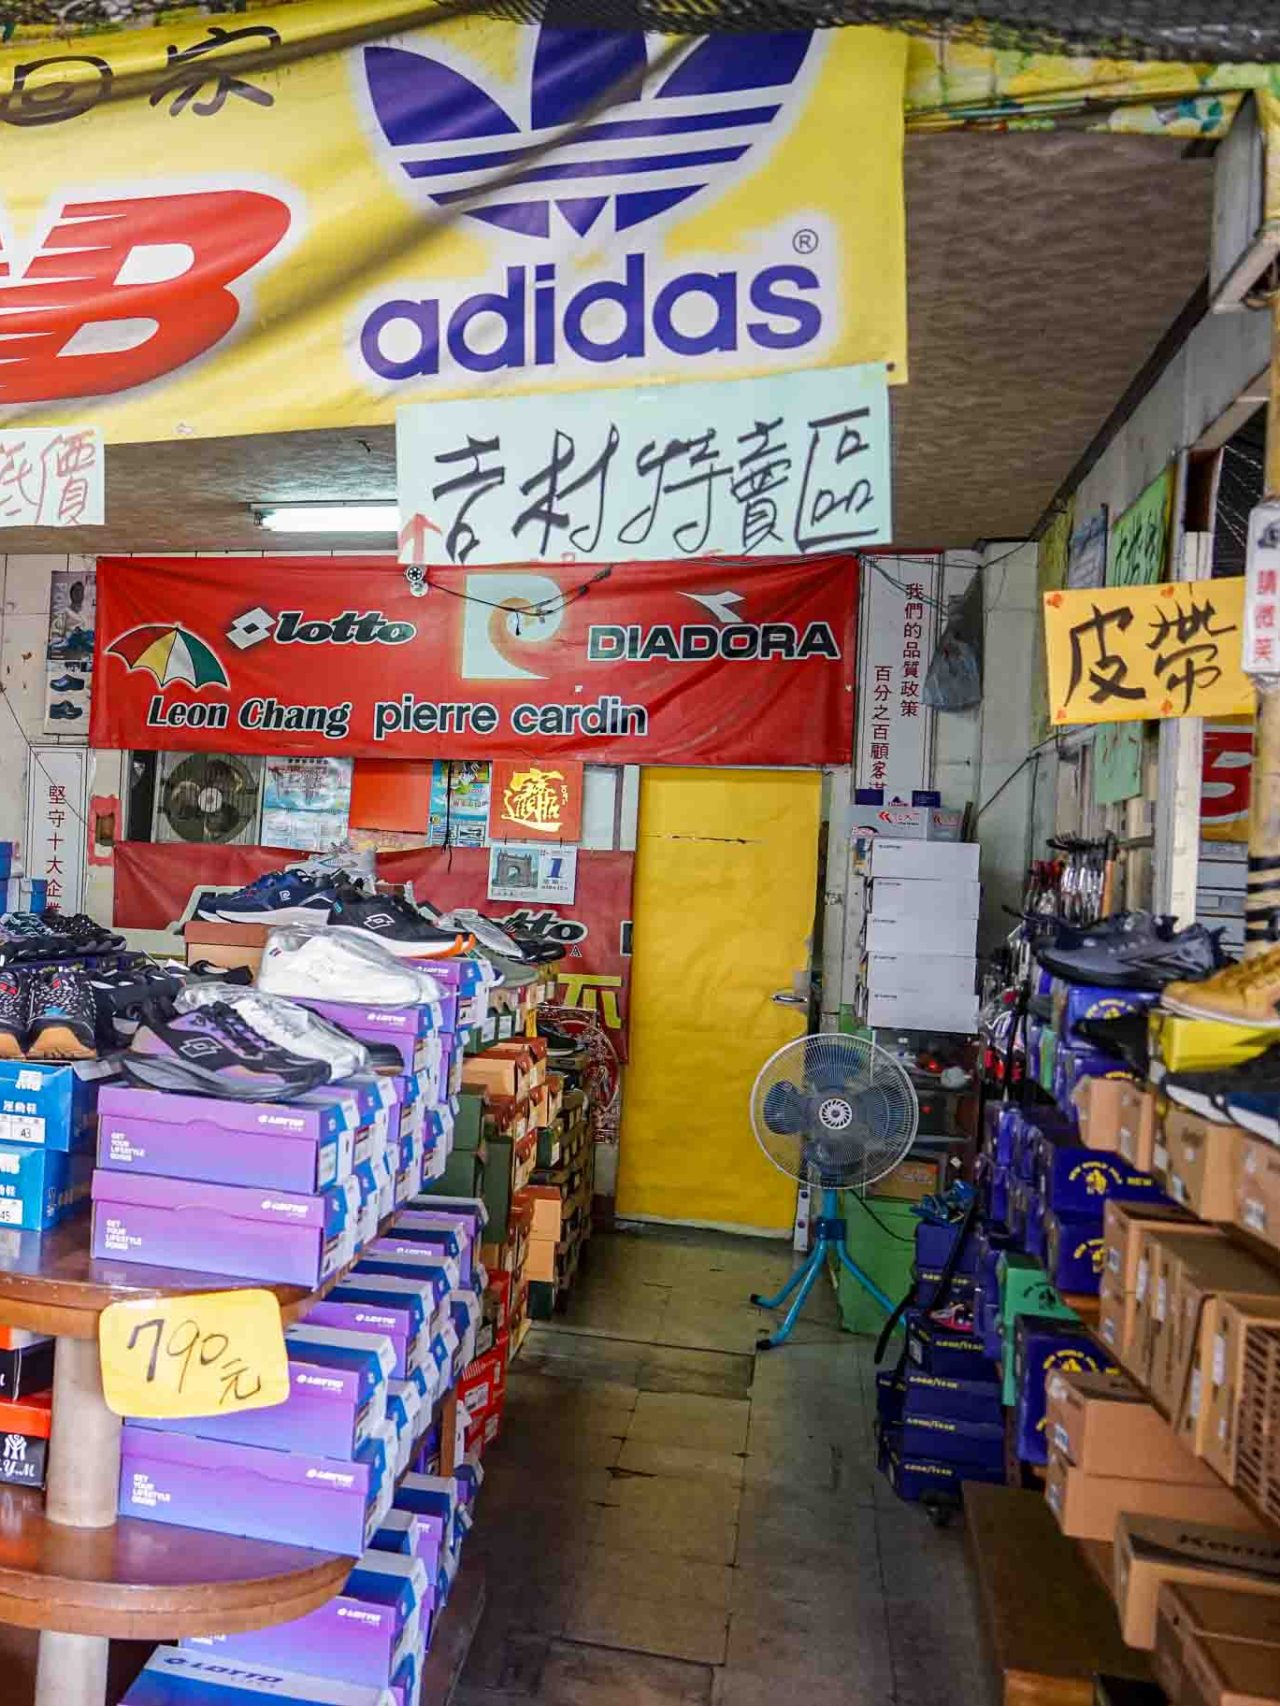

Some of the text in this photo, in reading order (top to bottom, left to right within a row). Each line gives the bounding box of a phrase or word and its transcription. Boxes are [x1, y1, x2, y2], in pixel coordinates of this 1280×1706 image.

[360, 253, 821, 380] adidas
[274, 610, 417, 645] lotto
[588, 621, 842, 660] DIADORA
[900, 583, 924, 718] 我們的品質政策
[1064, 599, 1237, 714] 皮帶
[147, 696, 353, 739] Leon Chang
[373, 692, 648, 740] pierre cardin
